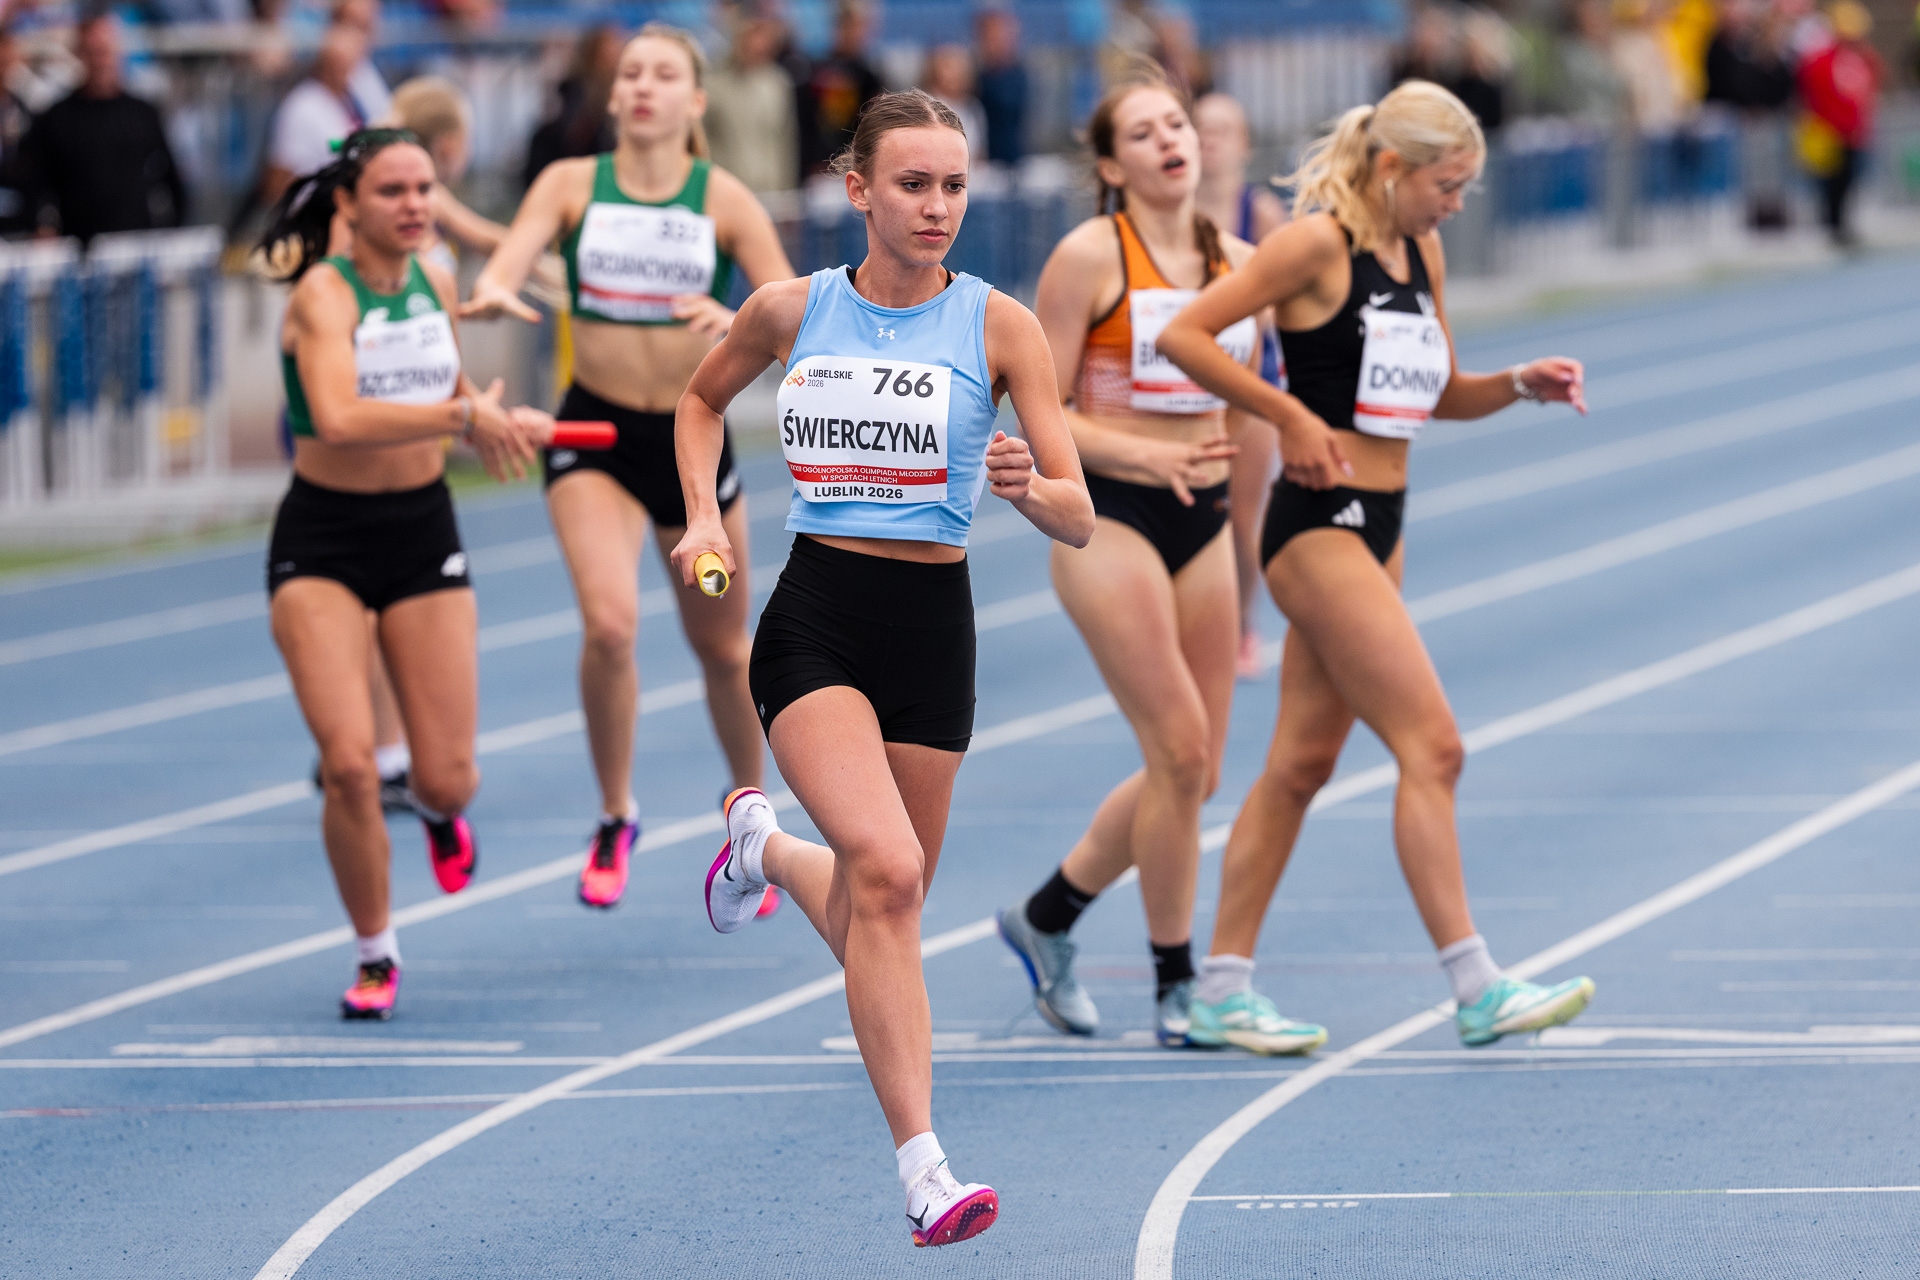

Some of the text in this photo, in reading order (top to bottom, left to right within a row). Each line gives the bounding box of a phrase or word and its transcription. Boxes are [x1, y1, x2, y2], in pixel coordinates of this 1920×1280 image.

[808, 368, 853, 380] LUBELSKIE
[807, 379, 824, 388] 2026
[872, 367, 934, 398] 766
[783, 408, 939, 454] ŚWIERCZYNA
[802, 465, 859, 474] OGÓLNOPOLSKA
[860, 467, 898, 476] OLIMPIADA
[898, 470, 938, 478] MŁODZIEŻY
[830, 474, 868, 482] SPORTACH
[869, 476, 898, 484] LETNICH
[814, 486, 903, 499] LUBLIN 2026
